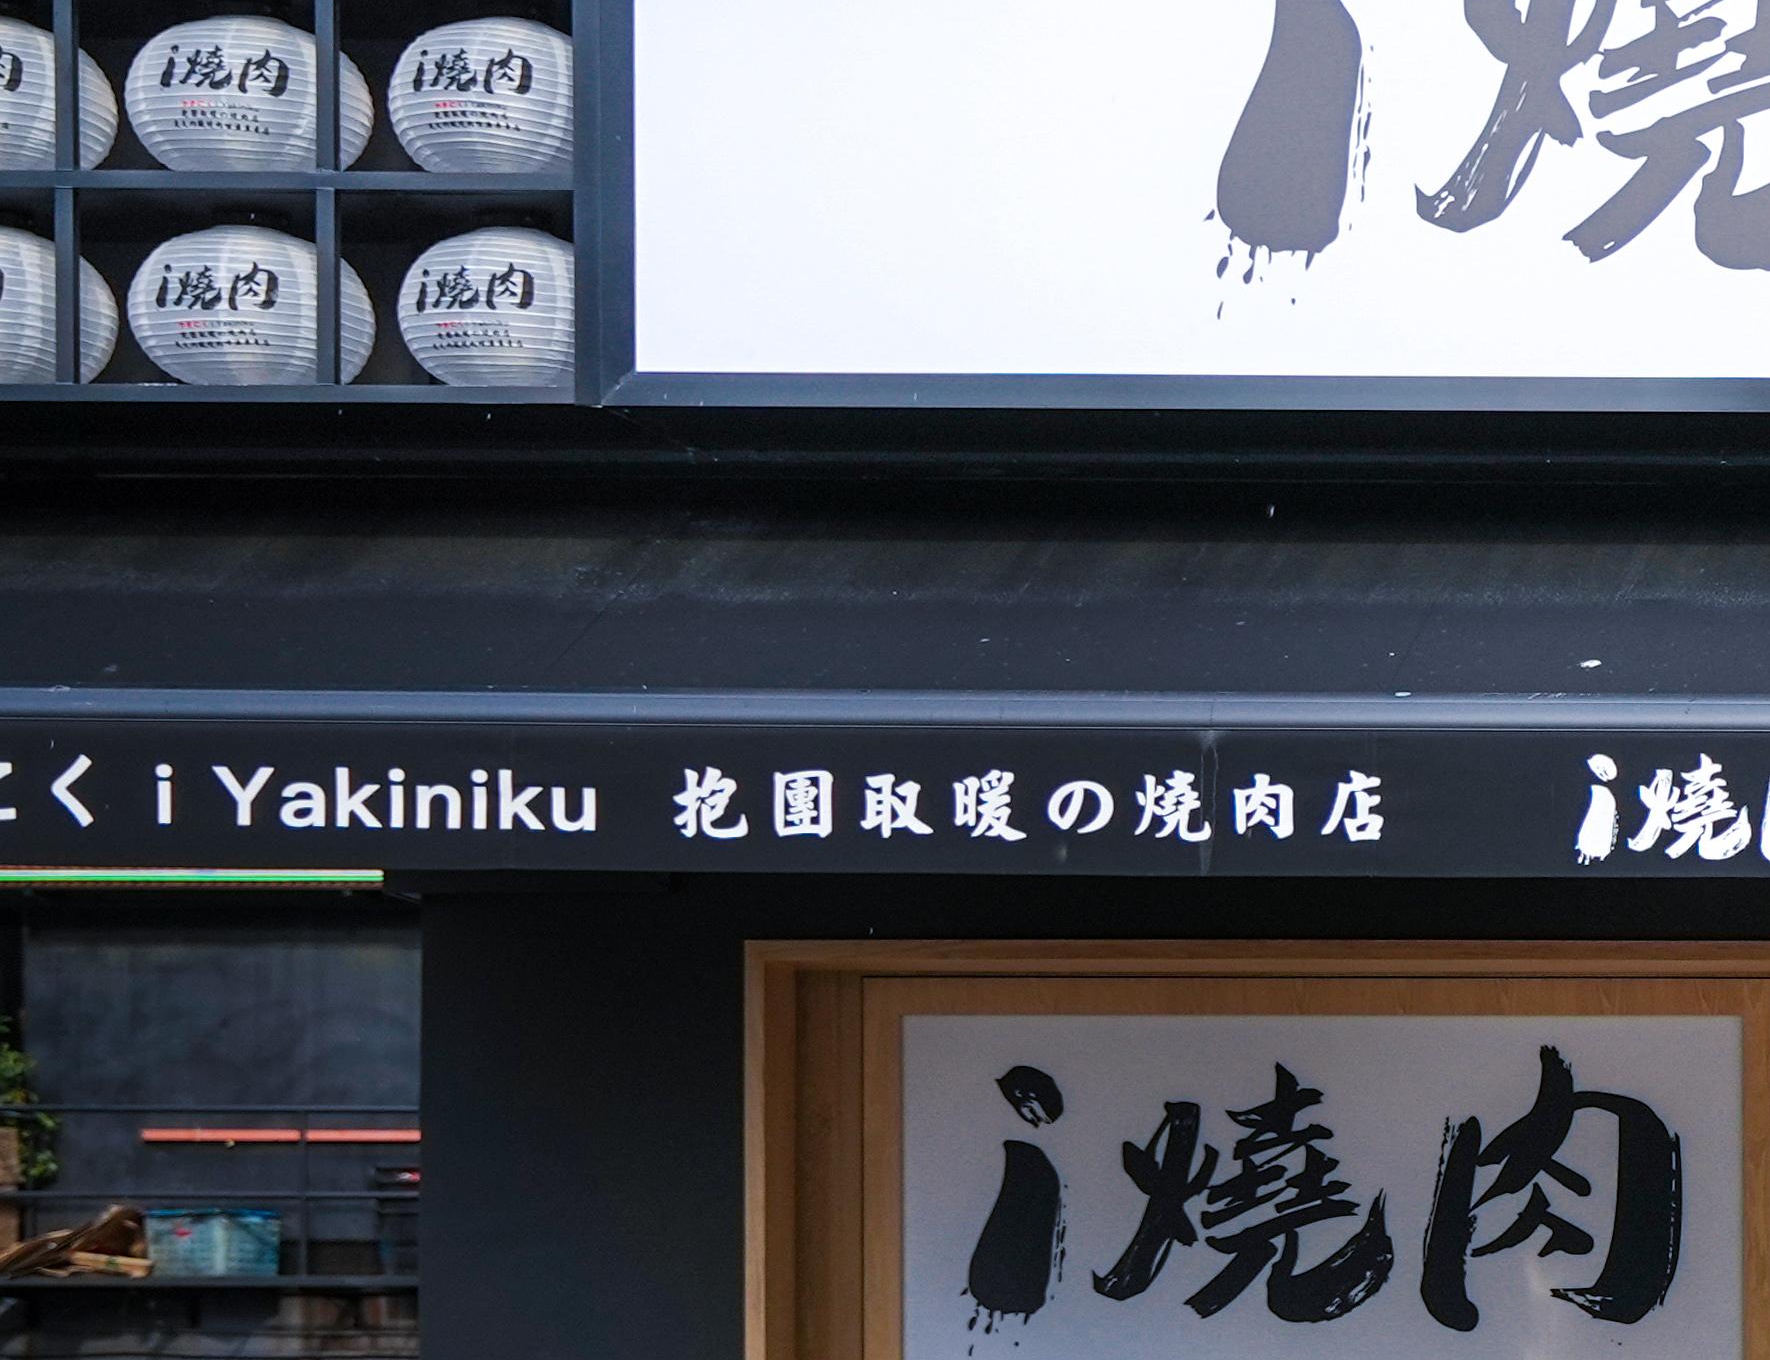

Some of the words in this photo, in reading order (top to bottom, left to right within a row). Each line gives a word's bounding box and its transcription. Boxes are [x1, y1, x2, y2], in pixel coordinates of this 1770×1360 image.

[0, 762, 93, 826] く
[156, 764, 172, 824] i
[213, 766, 596, 831] Yakiniku
[673, 767, 1383, 841] 抱團取暖の燒肉店
